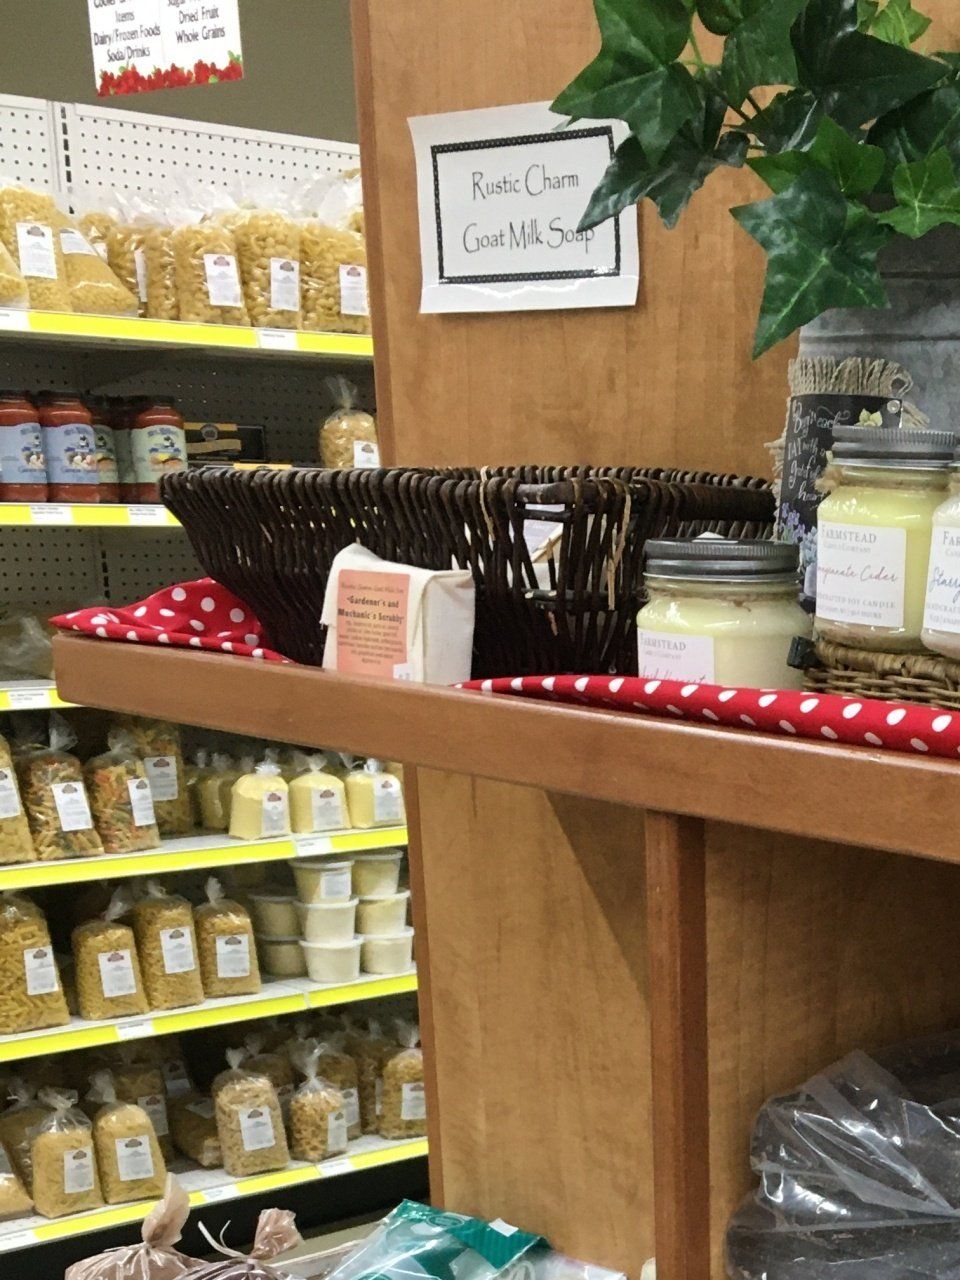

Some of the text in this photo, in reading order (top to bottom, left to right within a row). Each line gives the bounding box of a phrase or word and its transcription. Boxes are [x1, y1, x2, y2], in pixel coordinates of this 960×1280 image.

[115, 11, 135, 23] Items
[178, 6, 219, 24] Dried Fruit
[140, 23, 161, 37] Foods
[176, 25, 226, 44] Whole Grains
[472, 164, 579, 201] Rustic Charm
[463, 217, 595, 254] Goat Milk Soap
[822, 524, 877, 543] FARMSTEAD
[859, 565, 899, 583] Cider
[388, 600, 399, 608] and
